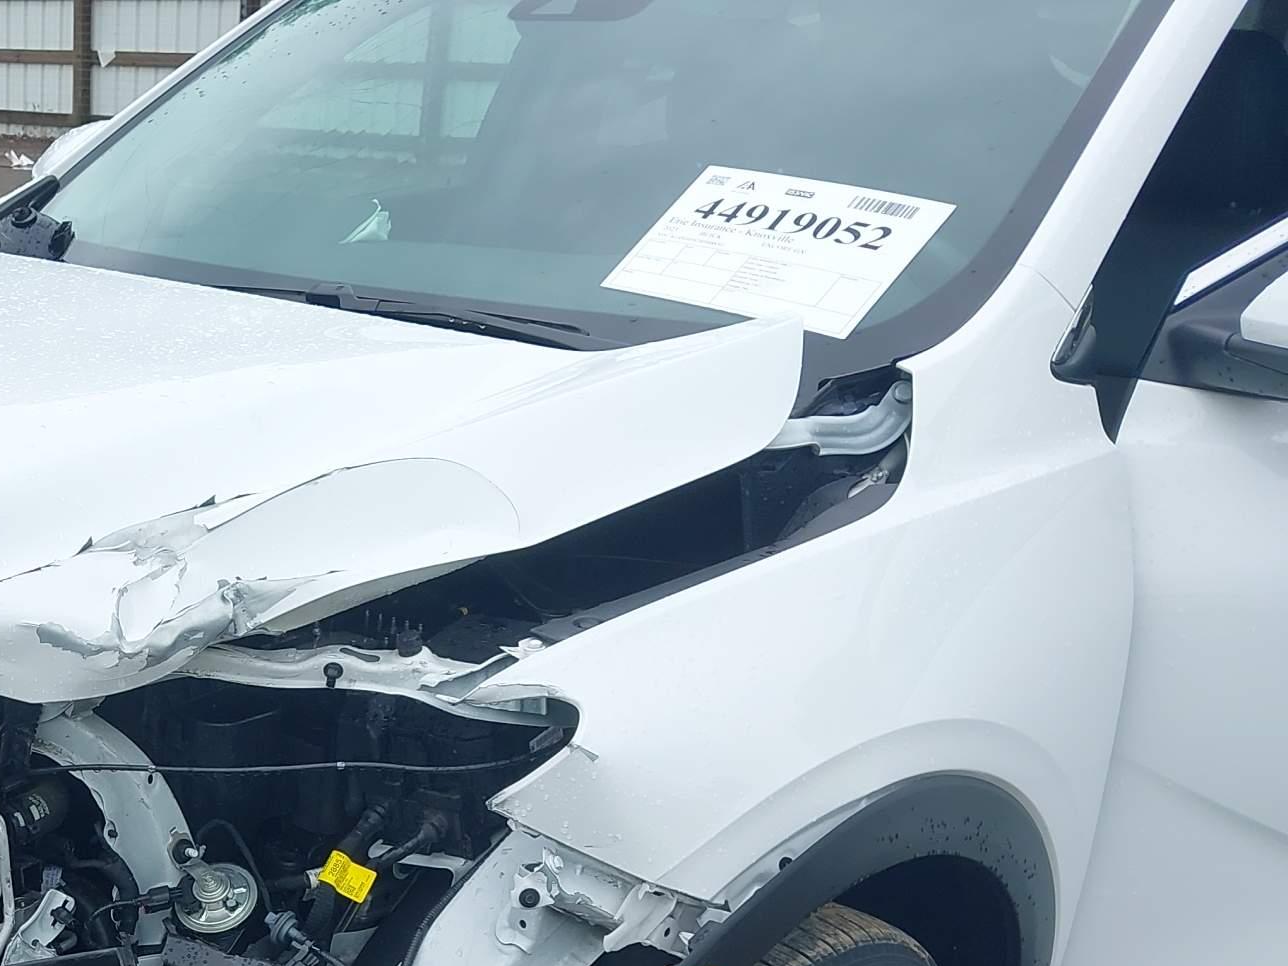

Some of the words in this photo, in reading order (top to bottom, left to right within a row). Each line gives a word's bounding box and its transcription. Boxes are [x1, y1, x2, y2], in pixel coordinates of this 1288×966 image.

[690, 219, 737, 234] Insurance
[745, 228, 795, 244] Knoxville
[695, 197, 893, 251] 44919052
